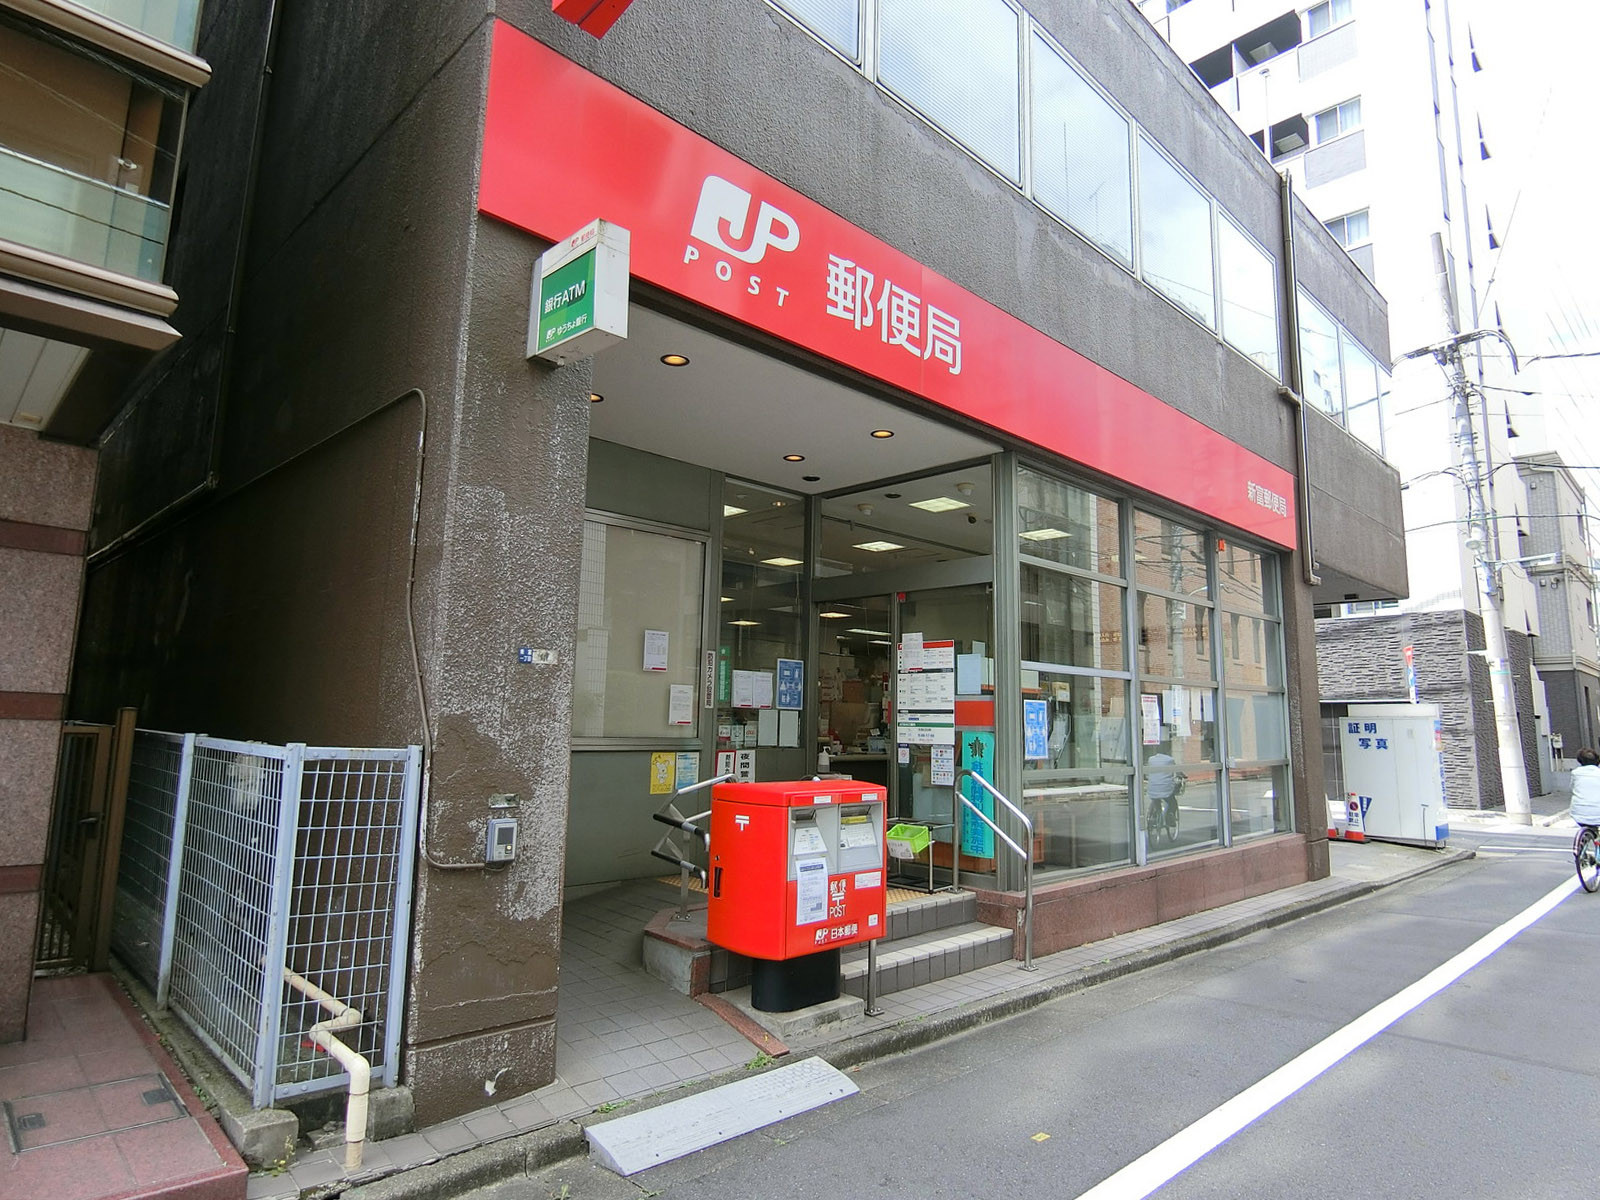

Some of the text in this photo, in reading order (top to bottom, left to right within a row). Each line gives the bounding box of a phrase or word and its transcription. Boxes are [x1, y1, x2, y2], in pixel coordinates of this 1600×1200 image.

[683, 245, 789, 307] POST
[544, 280, 586, 314] 銀行ATM
[557, 313, 588, 336] ゆうちょ銀行
[826, 253, 962, 375] 郵便局
[1247, 480, 1287, 518] 新富郵便局
[1348, 723, 1377, 734] 証明
[1359, 738, 1388, 749] 写真
[740, 753, 751, 783] 夜間警
[830, 879, 847, 895] 郵便
[829, 904, 846, 919] POST
[831, 923, 858, 939] 日本郵便
